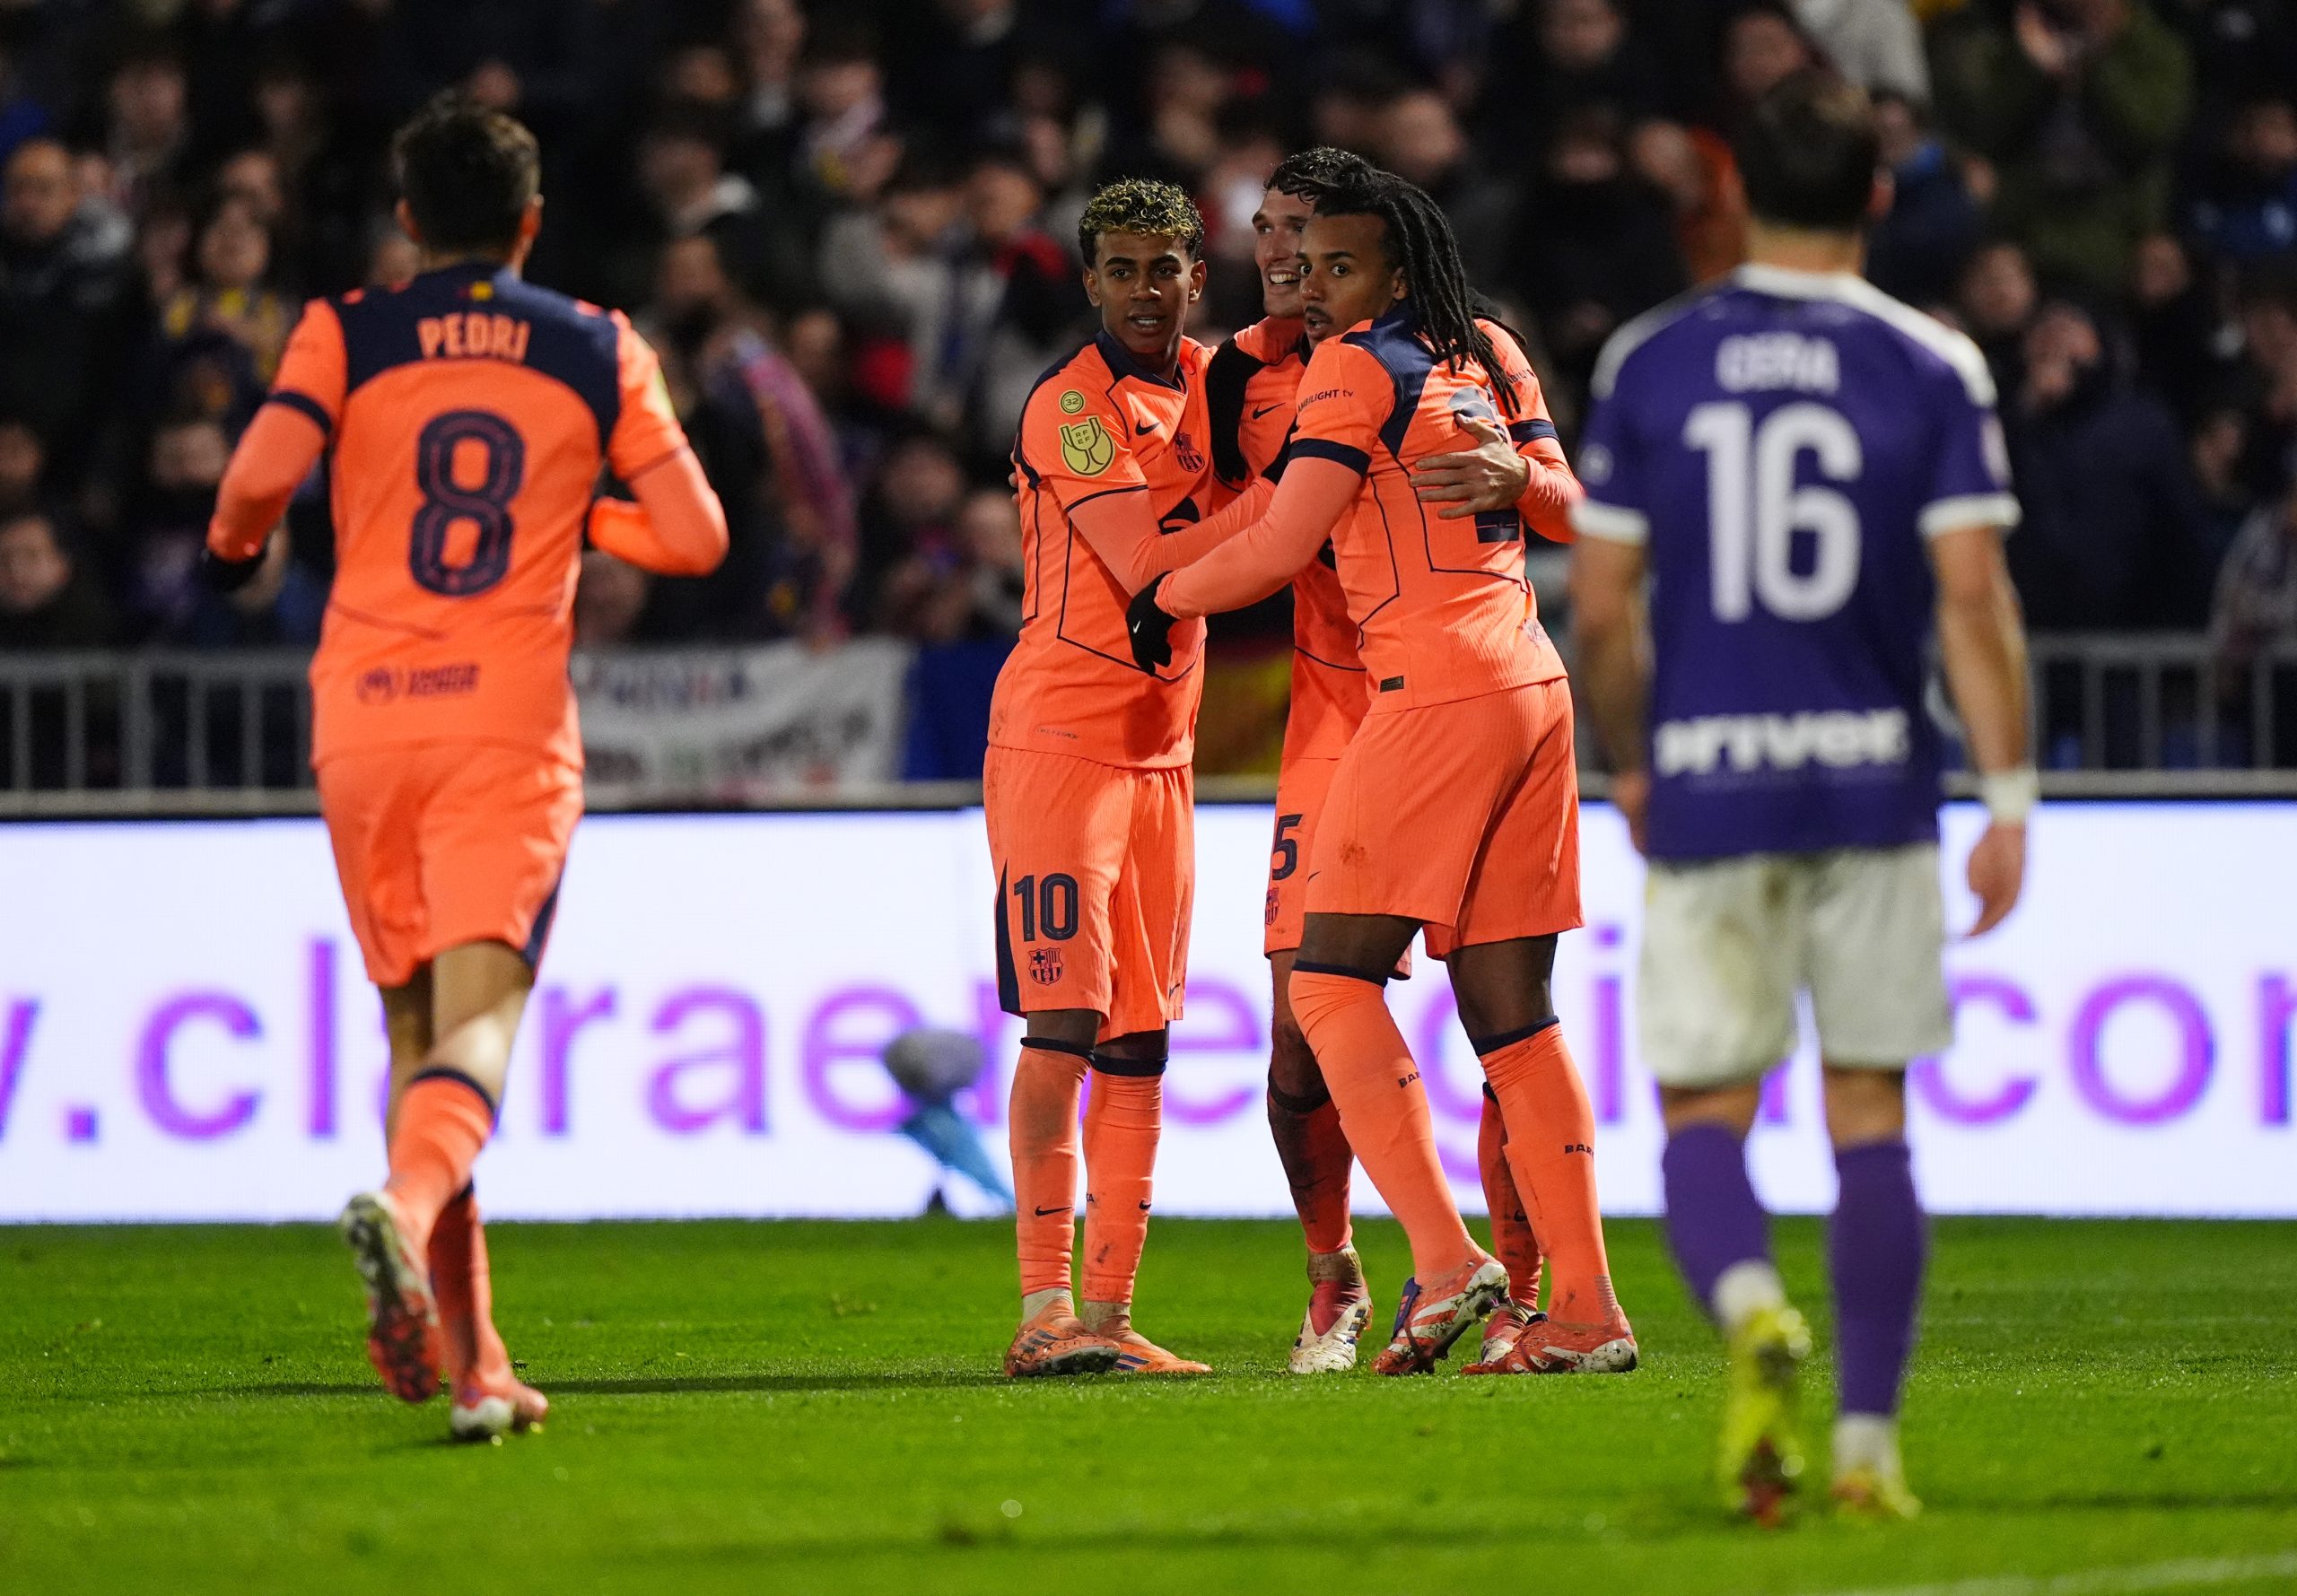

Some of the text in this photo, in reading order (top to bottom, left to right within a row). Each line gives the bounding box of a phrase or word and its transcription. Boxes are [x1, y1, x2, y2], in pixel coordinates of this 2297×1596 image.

[416, 312, 530, 362] PEDRI
[1065, 397, 1079, 406] 32
[409, 410, 526, 597] 8
[1681, 401, 1865, 624] 16
[1272, 814, 1303, 881] 5
[1013, 872, 1079, 942] 10
